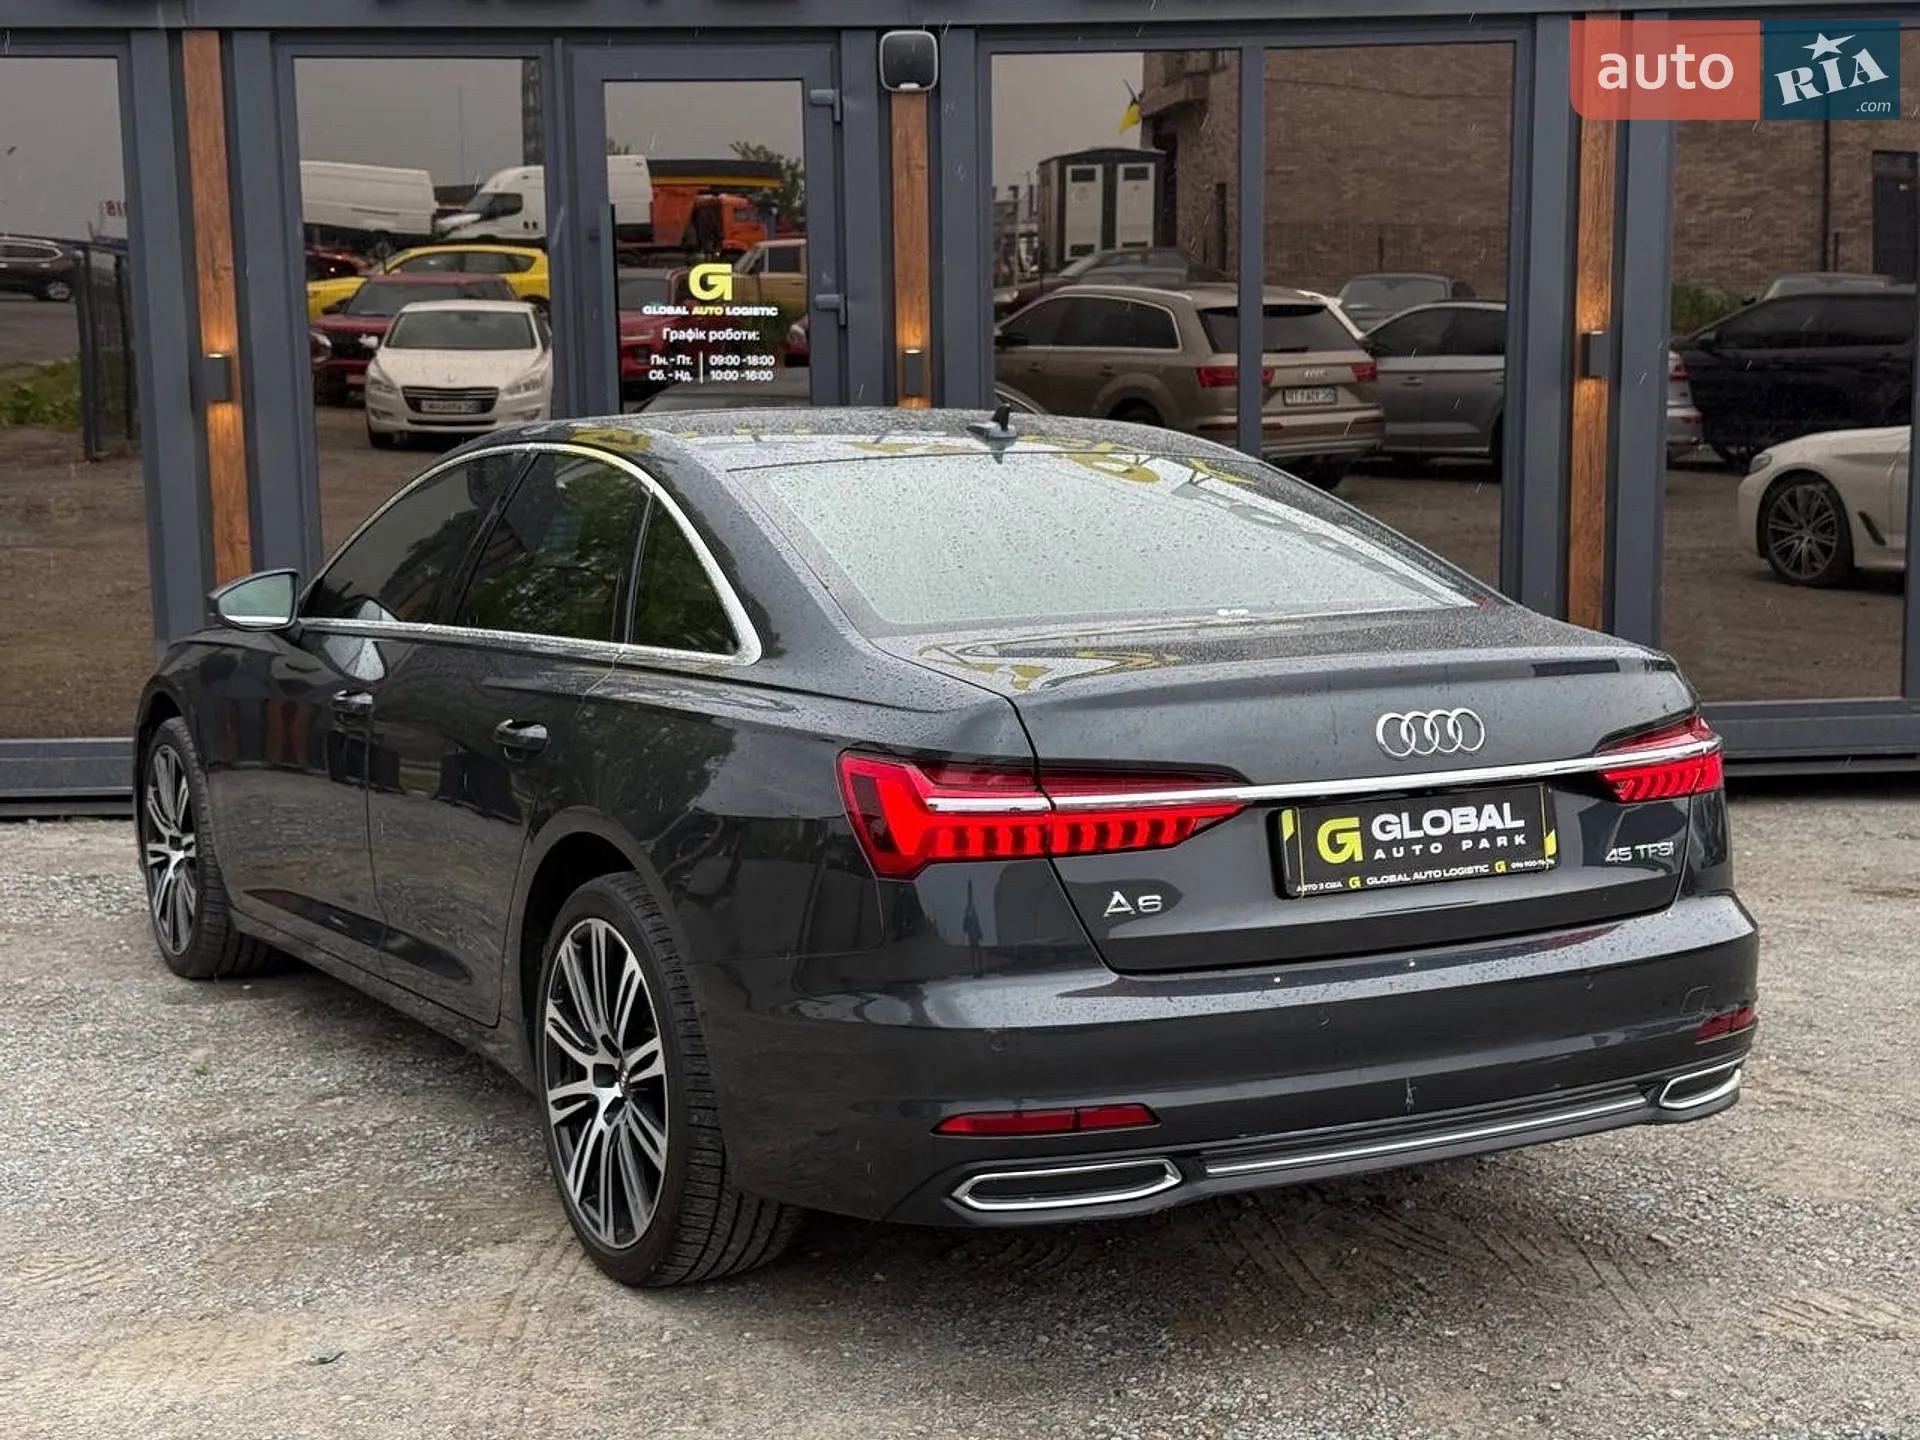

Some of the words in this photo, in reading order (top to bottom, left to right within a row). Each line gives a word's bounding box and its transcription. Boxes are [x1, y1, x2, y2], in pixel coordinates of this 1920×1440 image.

[642, 305, 689, 316] GLOBAL
[691, 305, 724, 316] AUTO
[725, 306, 779, 317] LOGISTIC
[662, 327, 706, 343] Графік
[708, 327, 761, 343] роботи:
[709, 354, 741, 366] 09:00
[710, 369, 739, 381] 10:00
[1370, 802, 1526, 841] GLOBAL
[1373, 842, 1443, 861] AUTO
[1461, 833, 1527, 852] PARK
[1605, 846, 1632, 863] 45
[1634, 841, 1675, 860] TFSI
[1366, 873, 1411, 885] GLOBAL
[1412, 868, 1442, 880] AUTO
[1443, 864, 1490, 877] LOGISTIC
